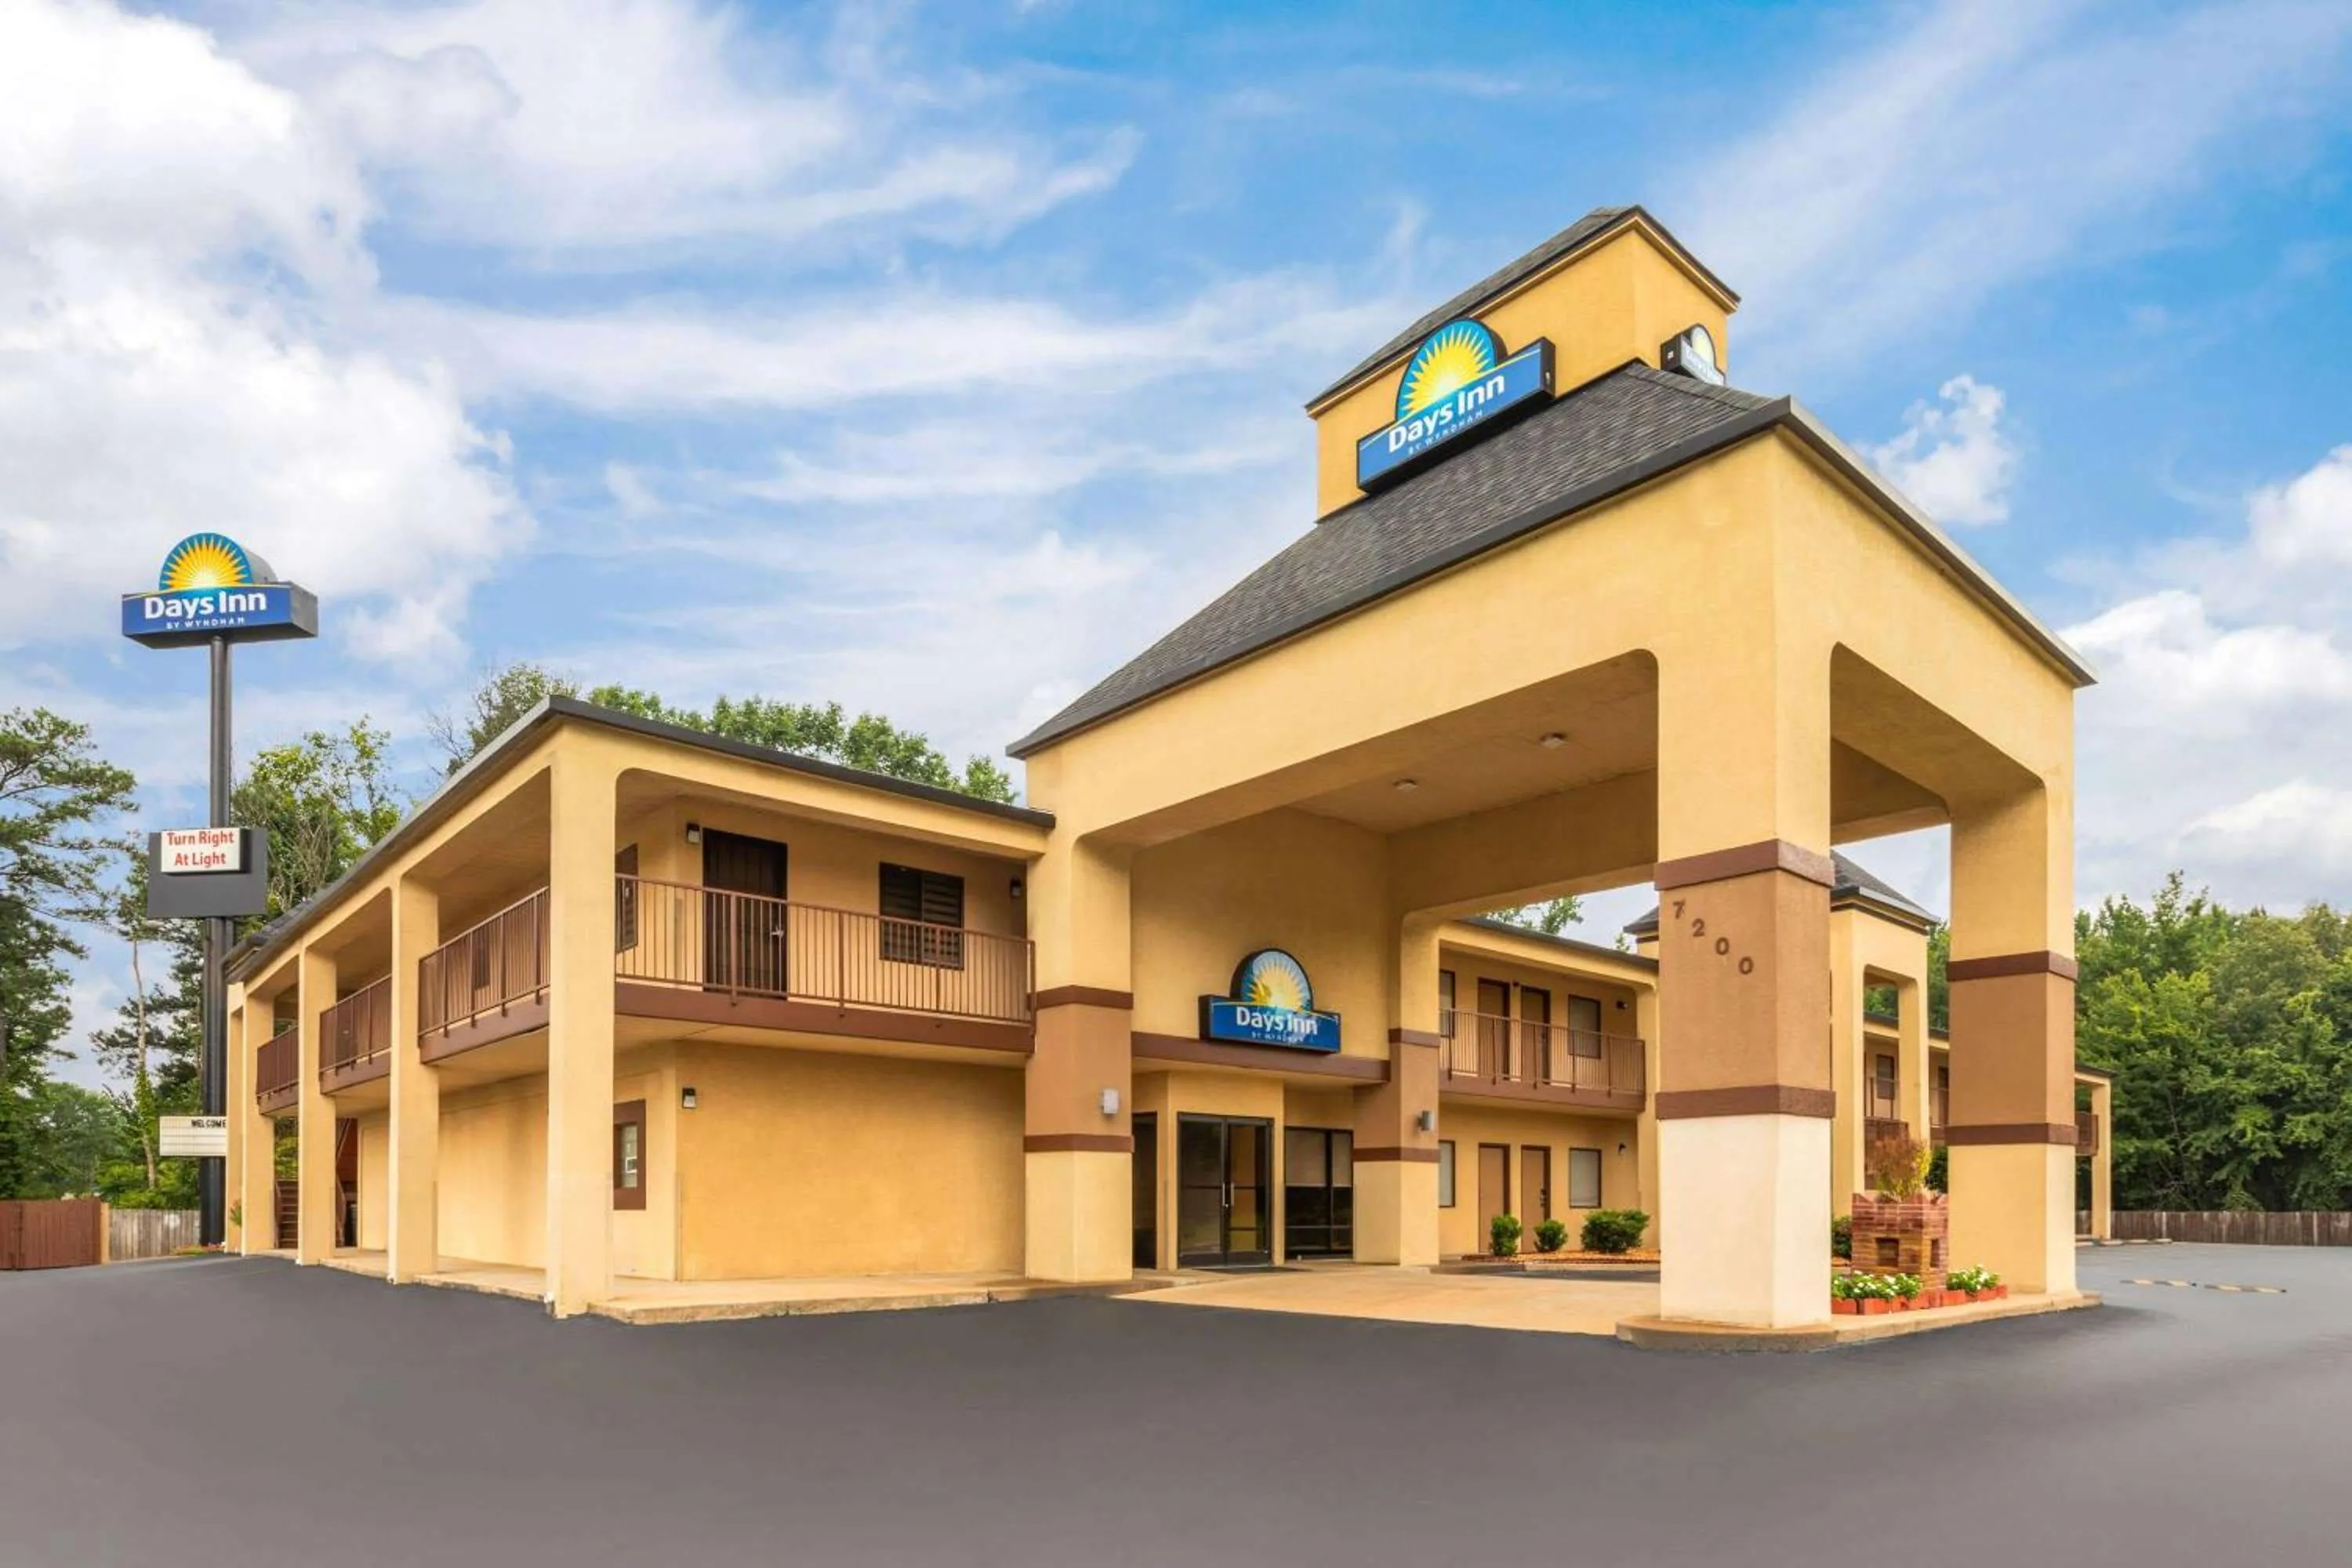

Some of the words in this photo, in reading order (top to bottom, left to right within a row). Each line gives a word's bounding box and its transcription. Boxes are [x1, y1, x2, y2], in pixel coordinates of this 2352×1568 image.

[1388, 402, 1453, 453] Days
[1457, 376, 1504, 415] Inn
[146, 597, 213, 619] Days
[220, 591, 267, 613] Inn
[185, 617, 245, 628] WYNDHAM
[167, 833, 195, 845] Turn
[198, 830, 234, 847] Right
[175, 853, 189, 866] At
[192, 851, 226, 868] Light
[1672, 899, 1754, 975] 7200
[1236, 1007, 1283, 1032] Days
[1287, 1014, 1317, 1035] Inn
